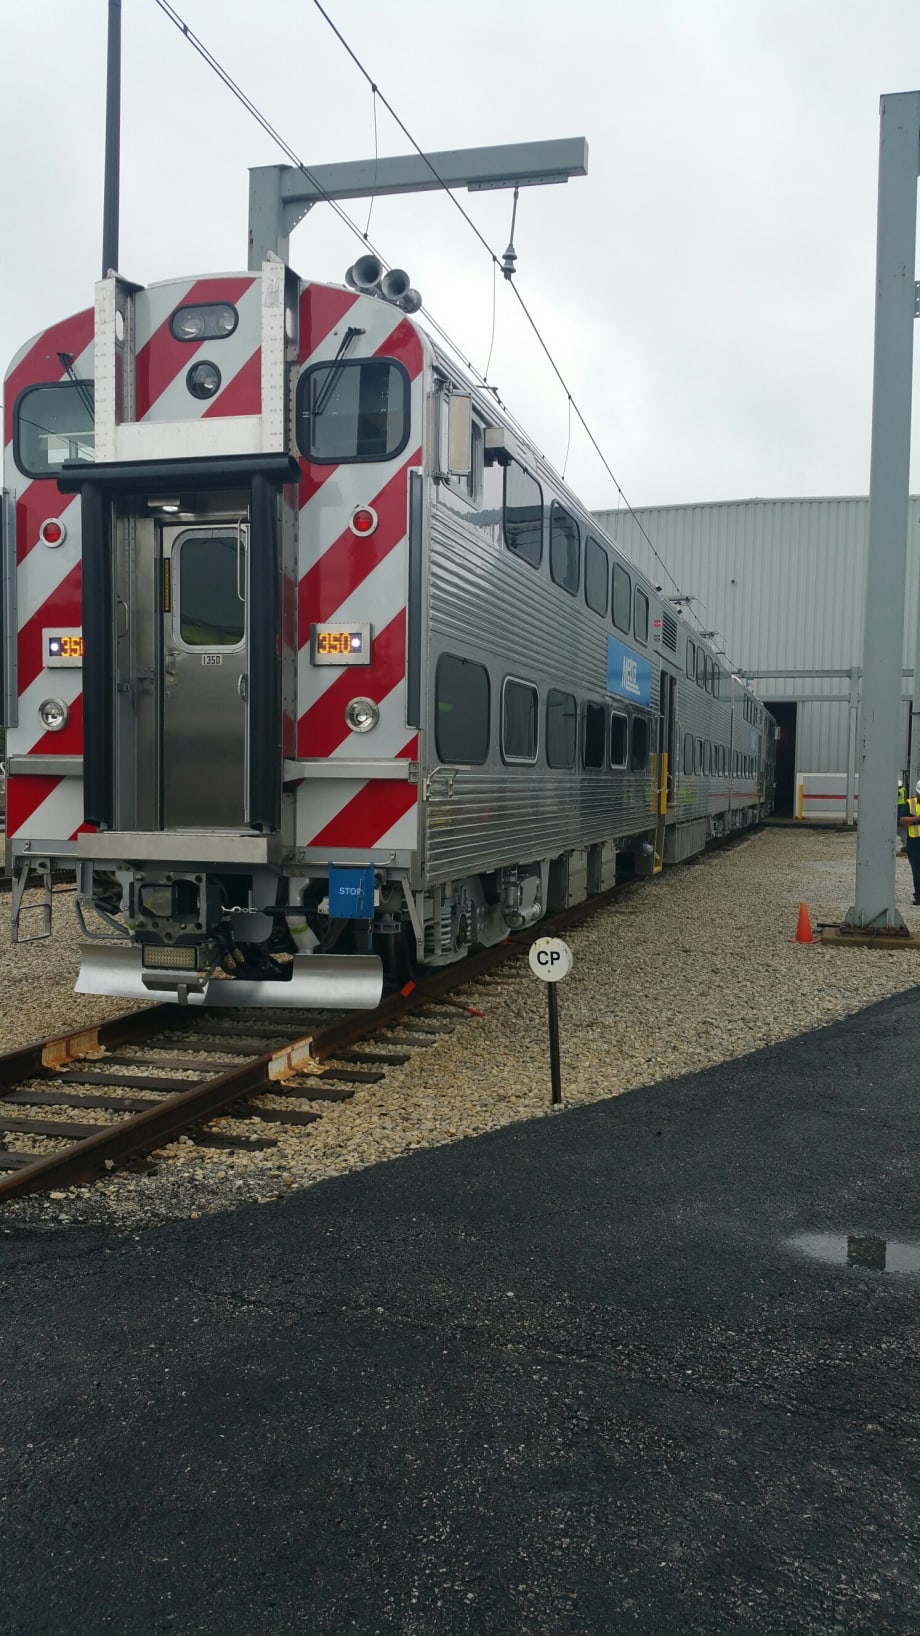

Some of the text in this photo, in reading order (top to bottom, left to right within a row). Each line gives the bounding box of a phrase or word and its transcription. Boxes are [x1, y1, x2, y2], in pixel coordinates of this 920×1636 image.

[61, 637, 83, 657] 35
[203, 655, 221, 665] 1350
[537, 950, 561, 966] CP
